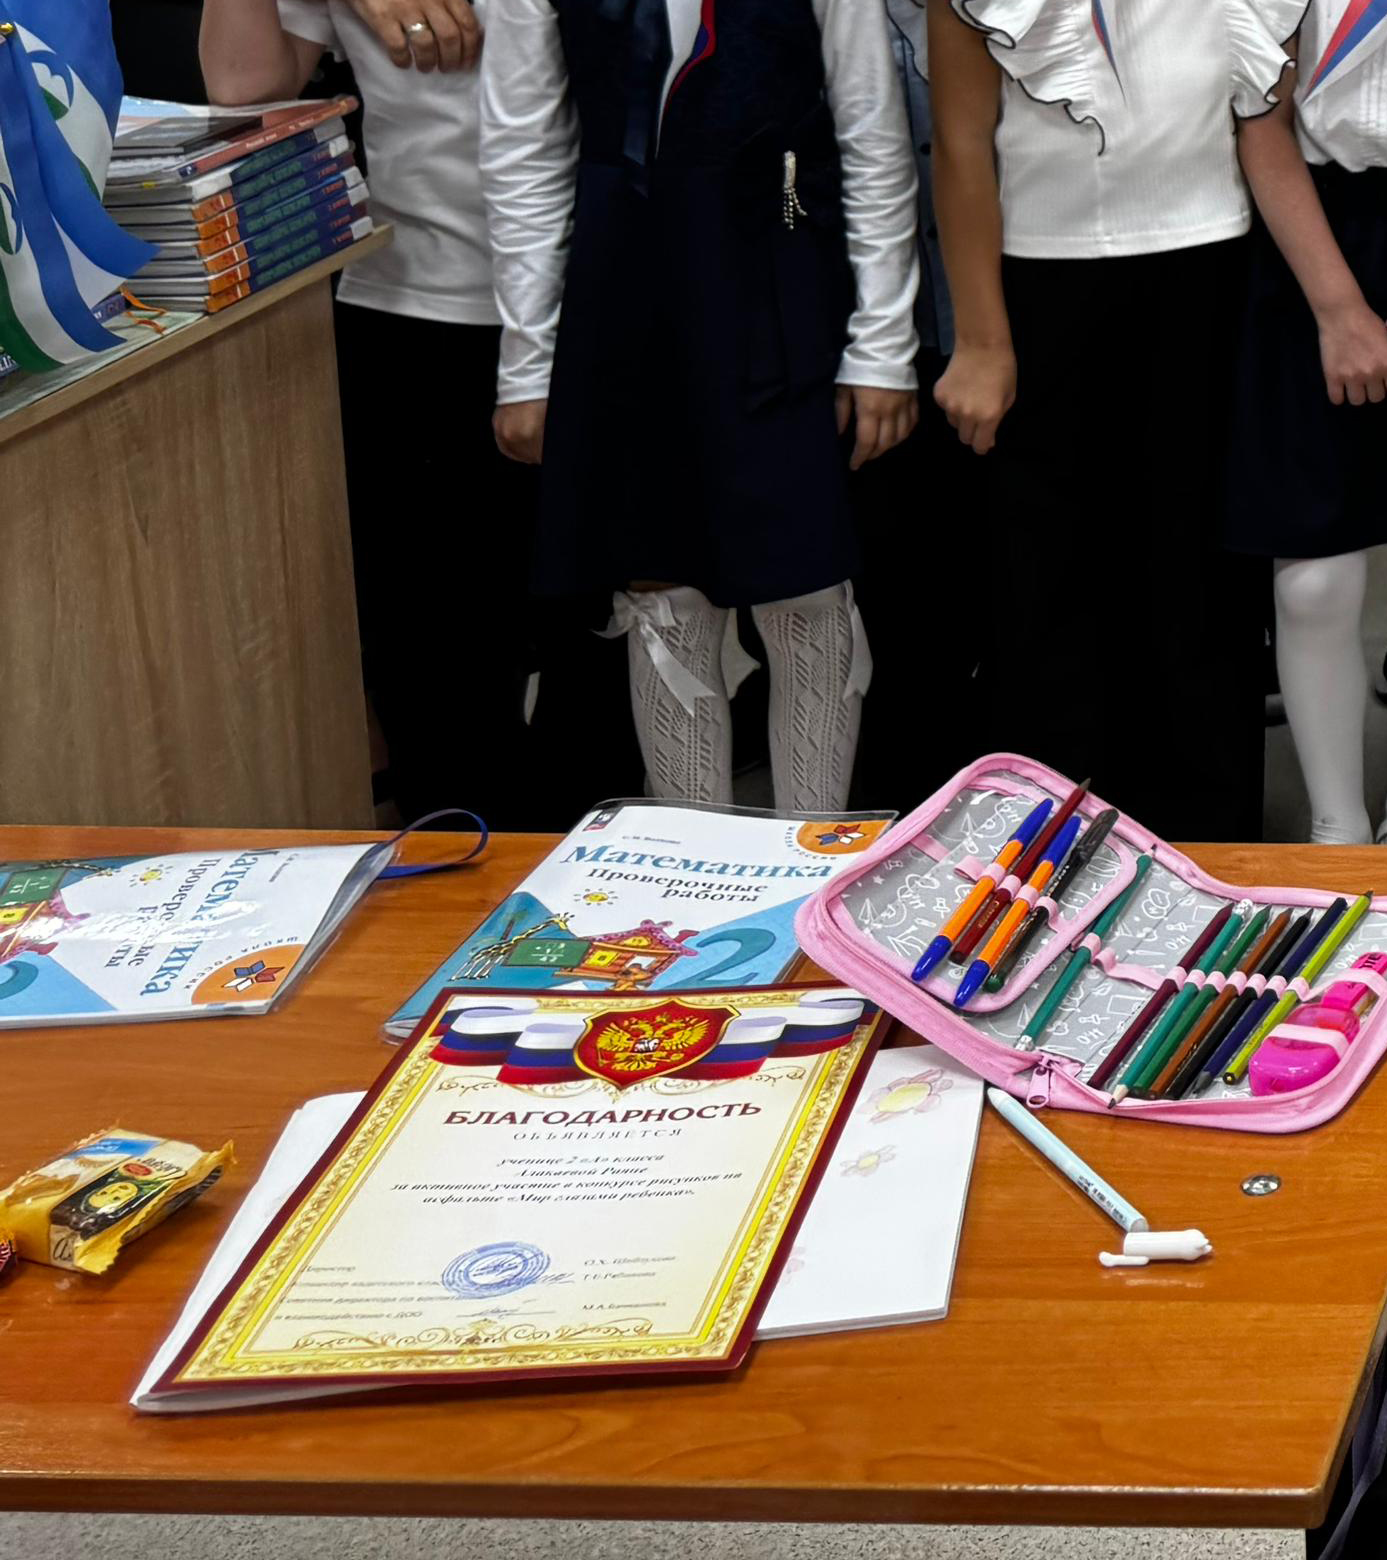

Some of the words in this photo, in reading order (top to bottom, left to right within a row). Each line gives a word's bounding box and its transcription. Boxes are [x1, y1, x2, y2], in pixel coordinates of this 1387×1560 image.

[559, 842, 833, 878] Математика
[585, 867, 768, 893] Проверочные
[661, 887, 760, 904] работы
[664, 927, 777, 989] 2
[443, 1103, 762, 1127] БЛАГОДАРНОСТЬ
[513, 1128, 683, 1142] ОБЪЯВЛЯЕТСЯ
[497, 1157, 563, 1168] ученице
[612, 1153, 665, 1164] класса
[646, 1173, 720, 1188] рисунков
